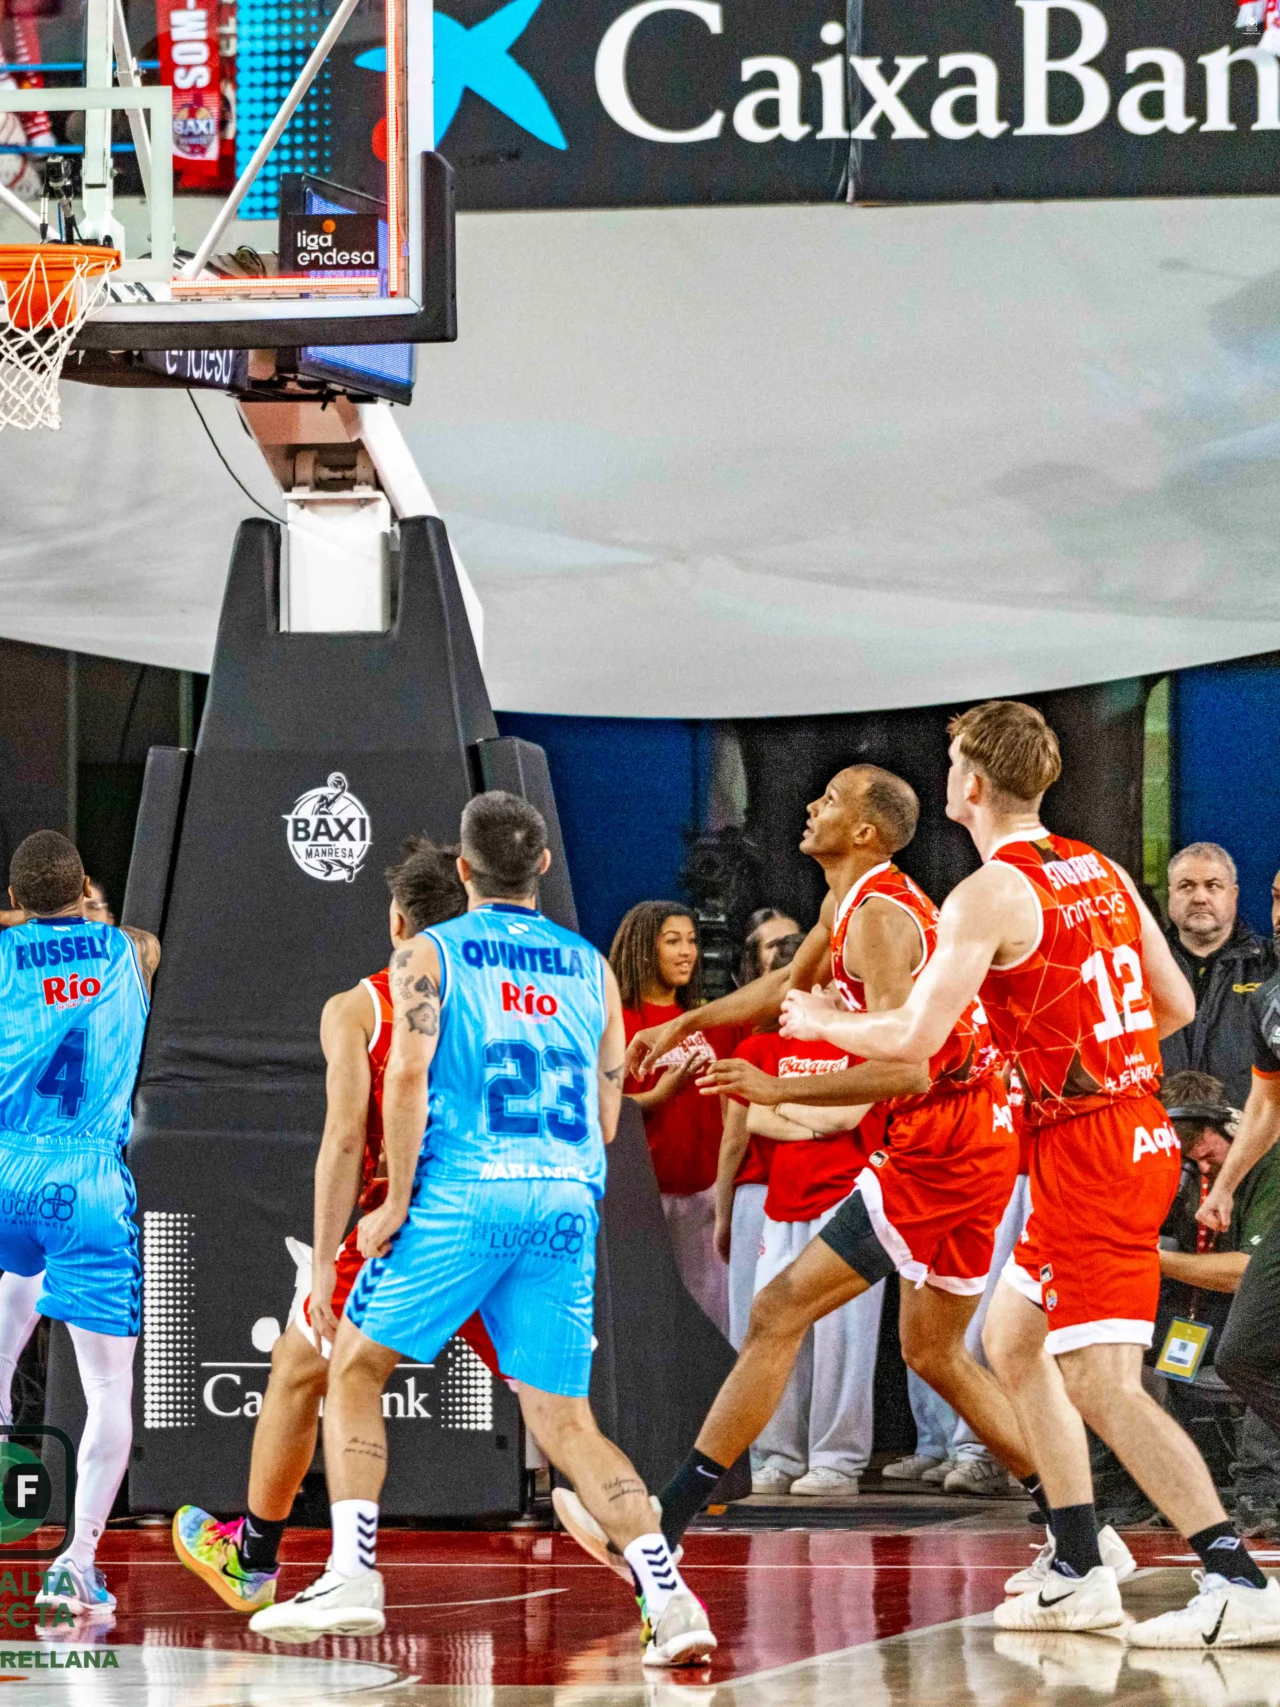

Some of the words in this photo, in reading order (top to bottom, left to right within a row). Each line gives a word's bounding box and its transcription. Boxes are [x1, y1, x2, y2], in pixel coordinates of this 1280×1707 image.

[173, 119, 215, 135] BAXI
[297, 230, 332, 250] liga
[297, 248, 375, 266] endesa
[292, 818, 366, 842] BAXI
[306, 848, 354, 860] MANRESA
[461, 939, 584, 980] QUINTELA
[43, 973, 101, 1006] Río
[501, 981, 557, 1016] Río
[1081, 944, 1154, 1043] 12
[34, 1027, 88, 1120] 4
[482, 1038, 590, 1146] 23
[490, 1230, 547, 1249] LUGO
